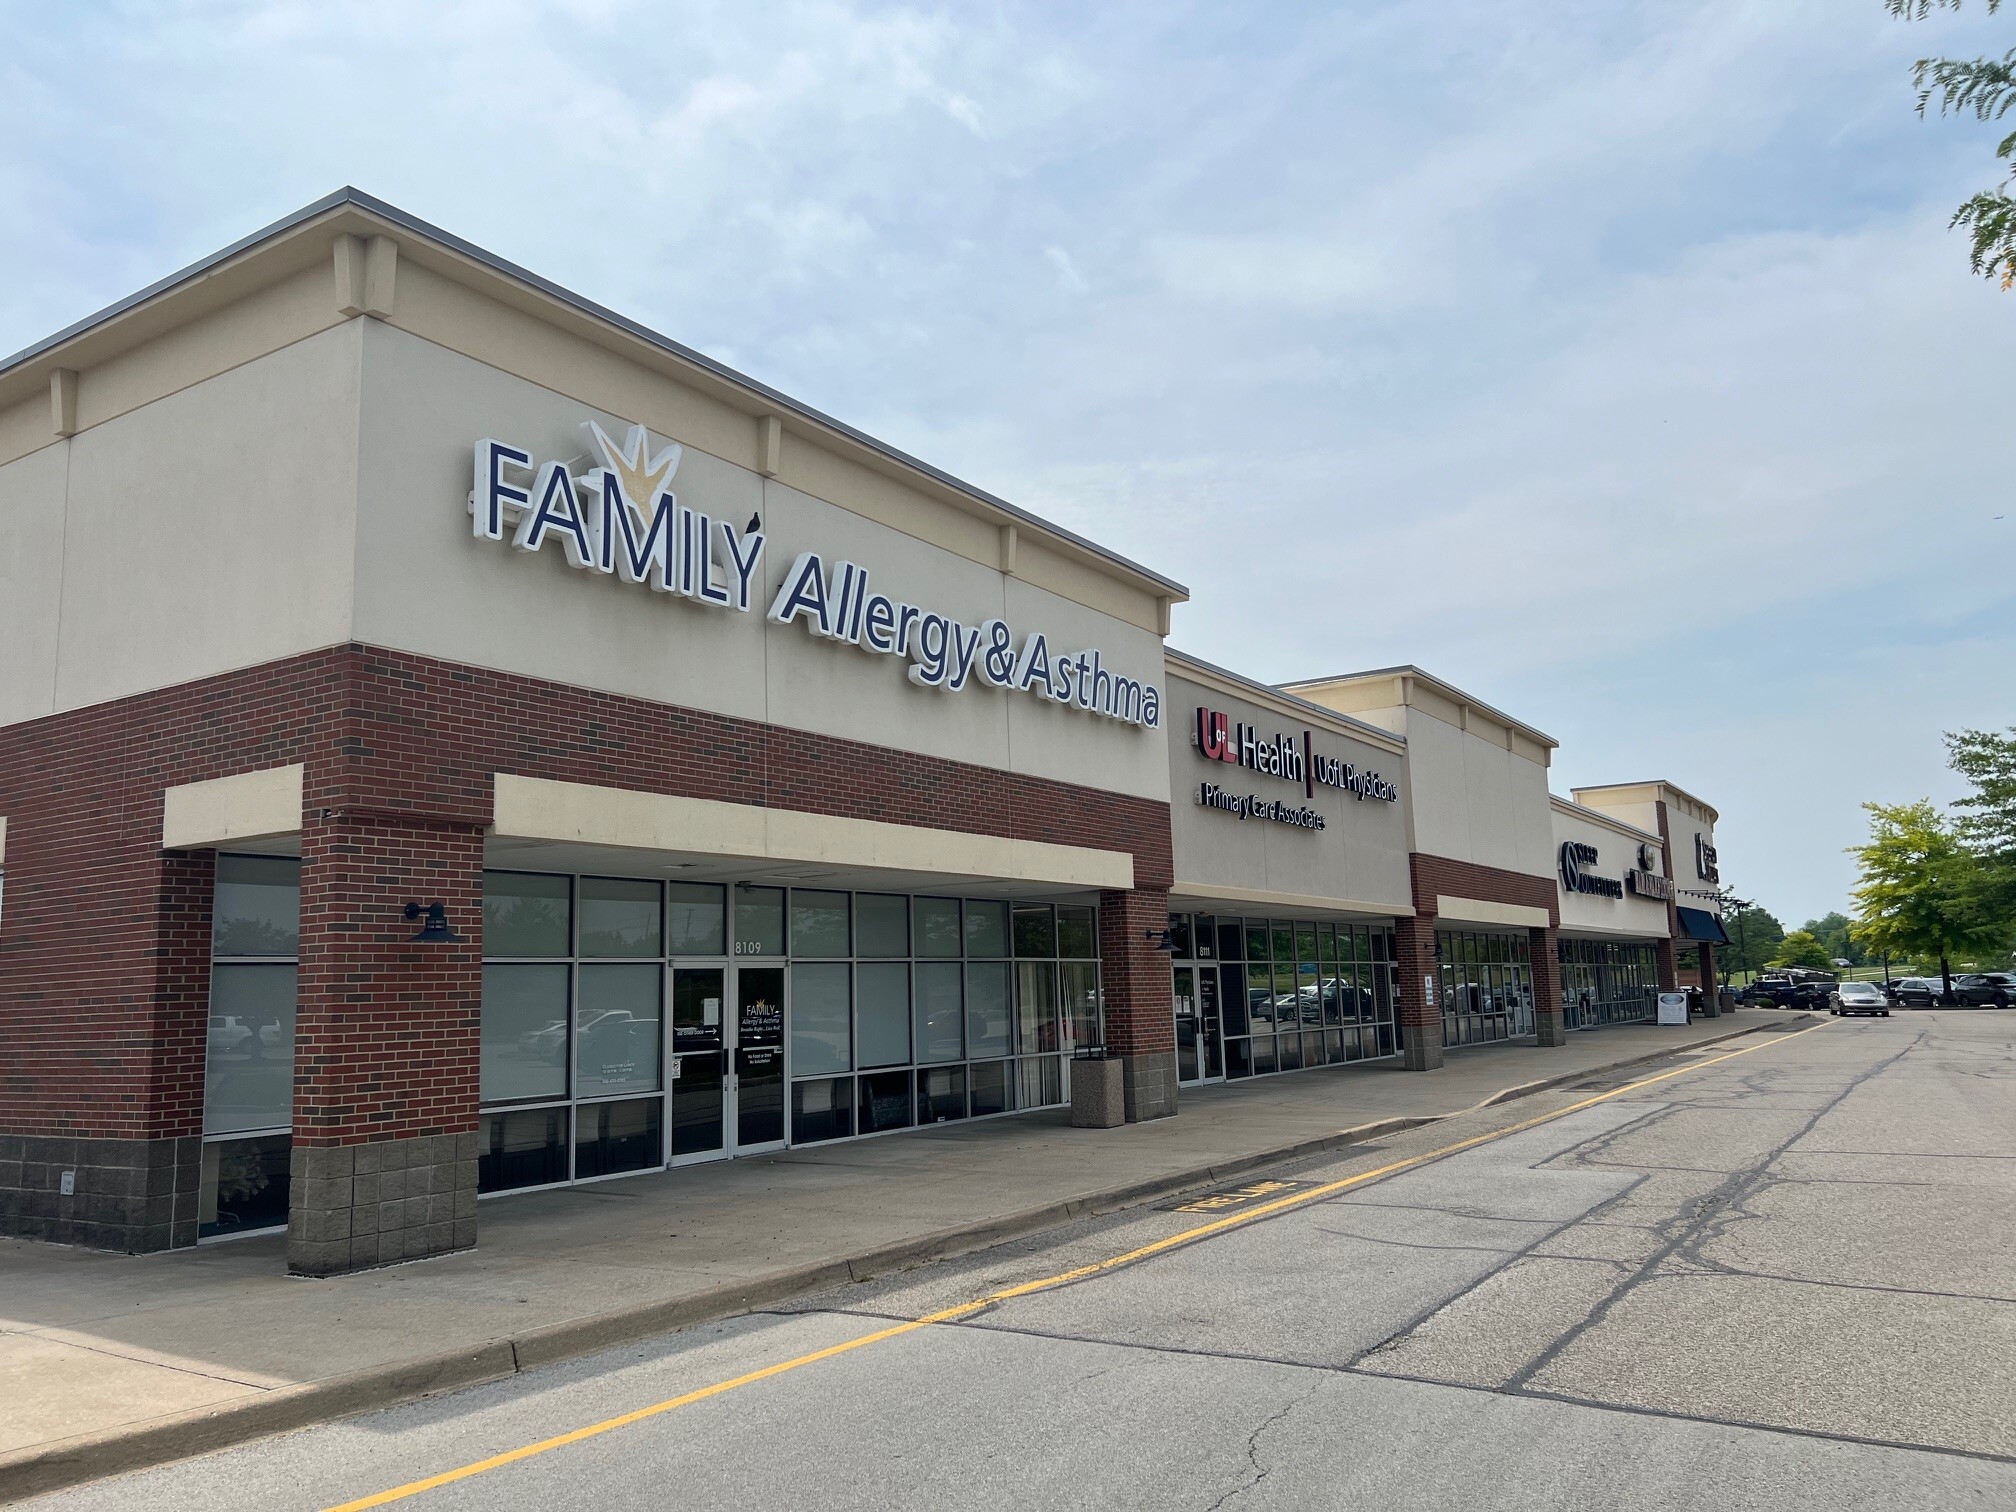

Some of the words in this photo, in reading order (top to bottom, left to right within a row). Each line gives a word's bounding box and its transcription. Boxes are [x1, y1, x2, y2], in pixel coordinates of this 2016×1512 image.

[477, 438, 767, 612] FAMILY
[771, 552, 981, 691] Allergy
[981, 620, 1018, 687] &
[1018, 633, 1161, 729] Asthma
[1238, 723, 1304, 782] Health
[1345, 763, 1398, 802] Physicians
[1202, 782, 1250, 819] Primary
[1251, 794, 1276, 819] Care
[1276, 801, 1326, 830] Associates
[735, 942, 761, 954] 8109
[746, 1005, 775, 1016] FAMILY
